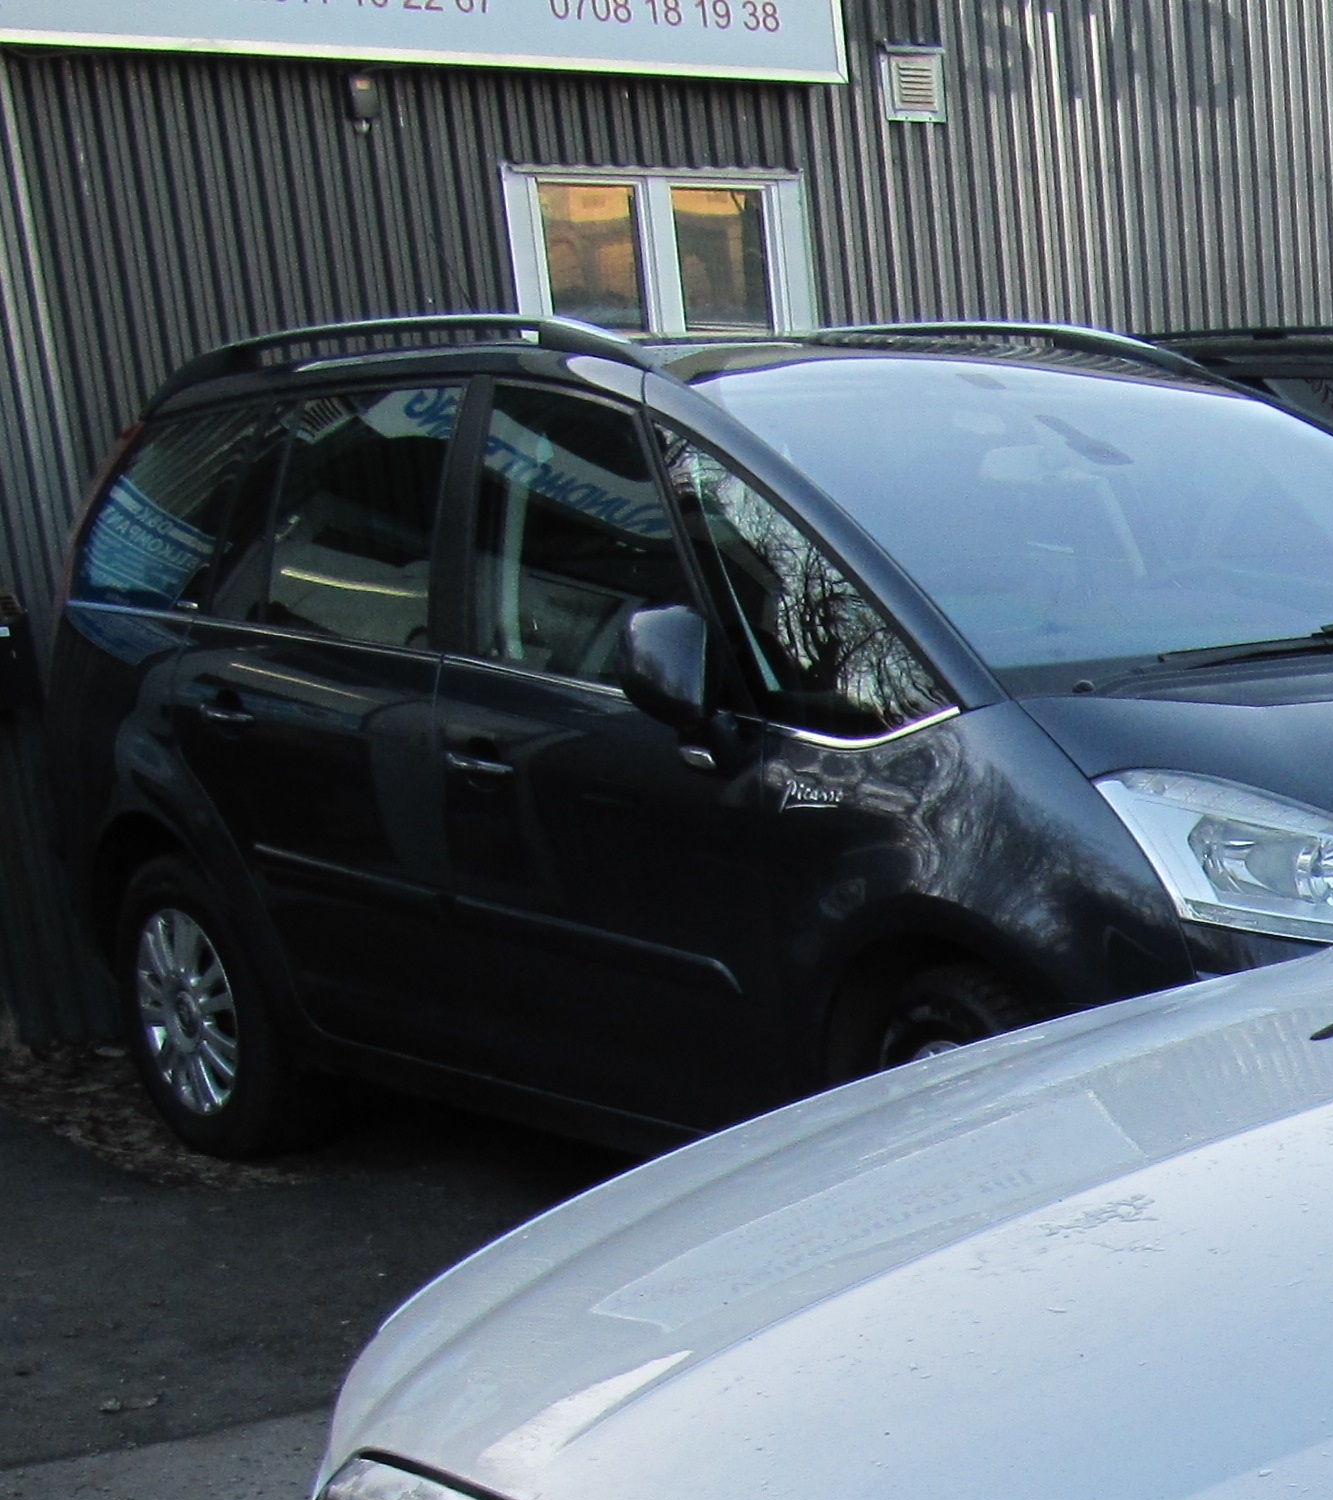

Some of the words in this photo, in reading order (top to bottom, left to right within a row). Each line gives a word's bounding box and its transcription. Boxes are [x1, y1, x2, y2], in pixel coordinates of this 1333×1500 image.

[645, 0, 682, 27] 18
[695, 0, 731, 30] 19
[741, 0, 780, 33] 38
[778, 778, 844, 814] Picasso
